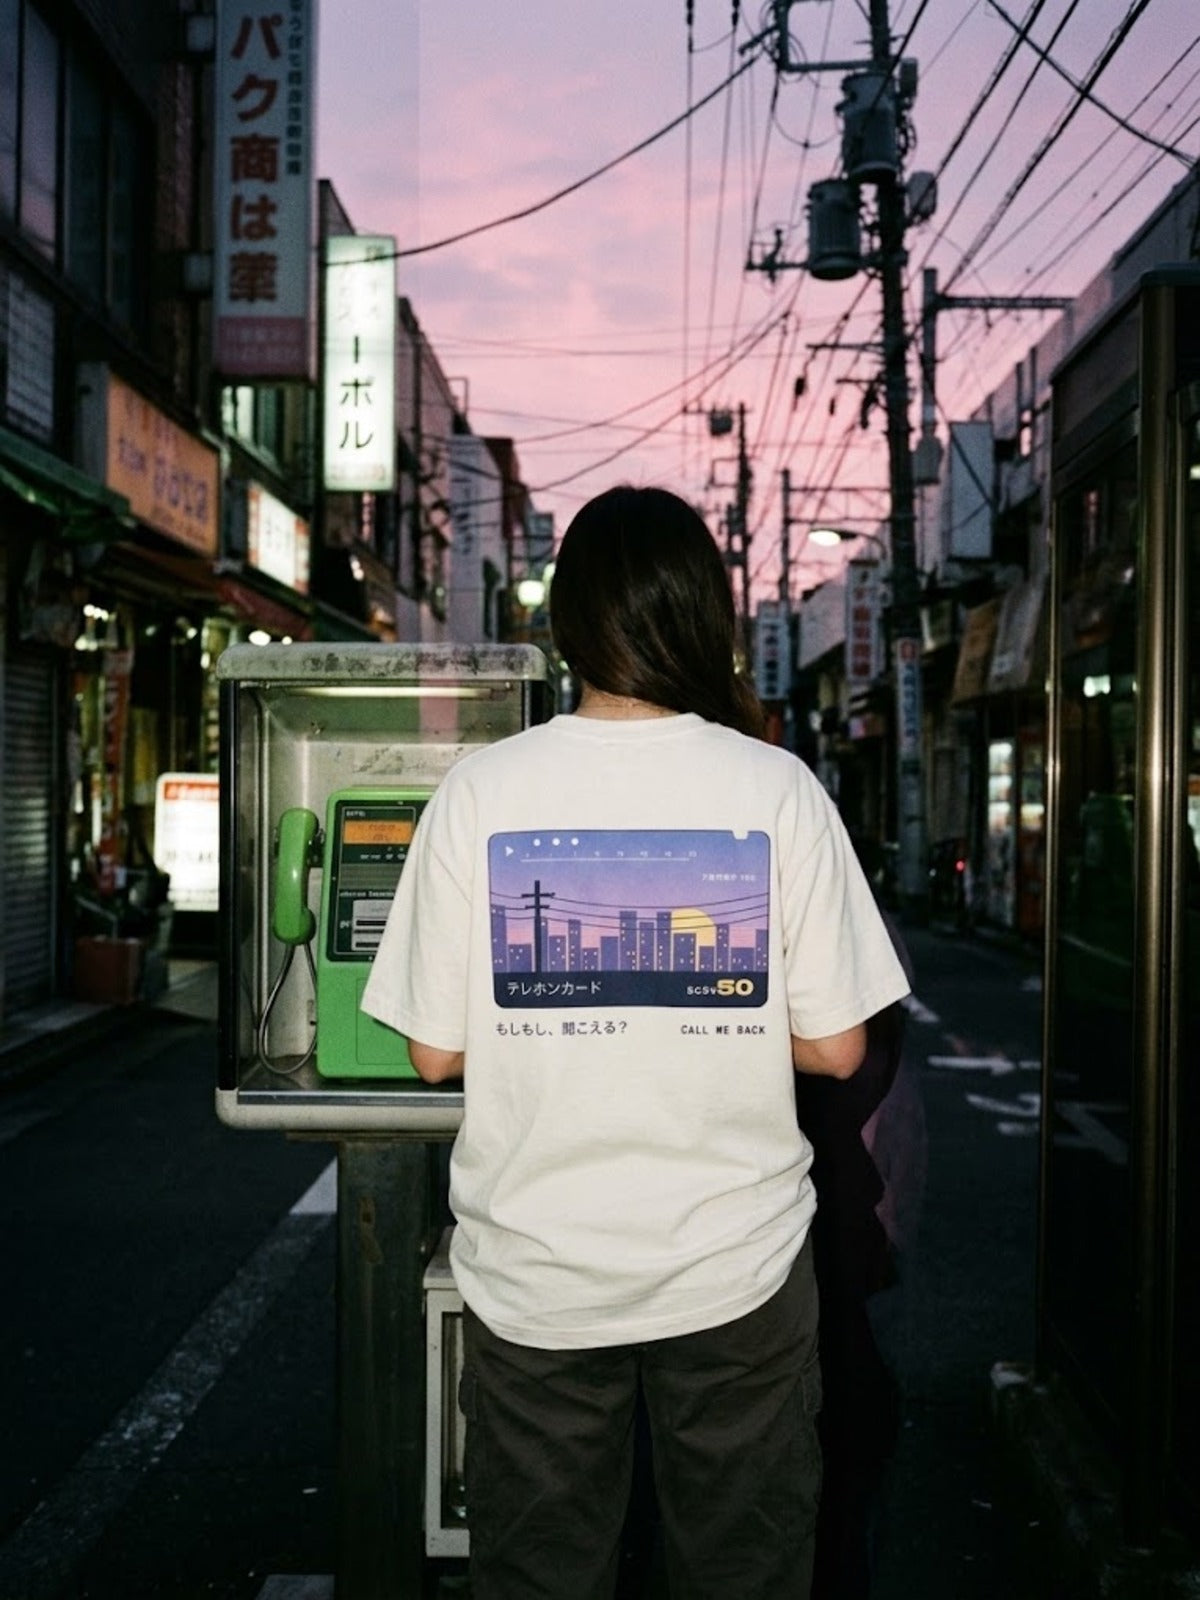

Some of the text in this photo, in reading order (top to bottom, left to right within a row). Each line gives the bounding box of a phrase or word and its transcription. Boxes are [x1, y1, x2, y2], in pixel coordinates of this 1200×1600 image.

[507, 980, 602, 996] テレホンカード
[716, 978, 754, 997] 50
[496, 1020, 628, 1036] もしもし、聞こえる？
[681, 1025, 766, 1035] CALL ME BACK
